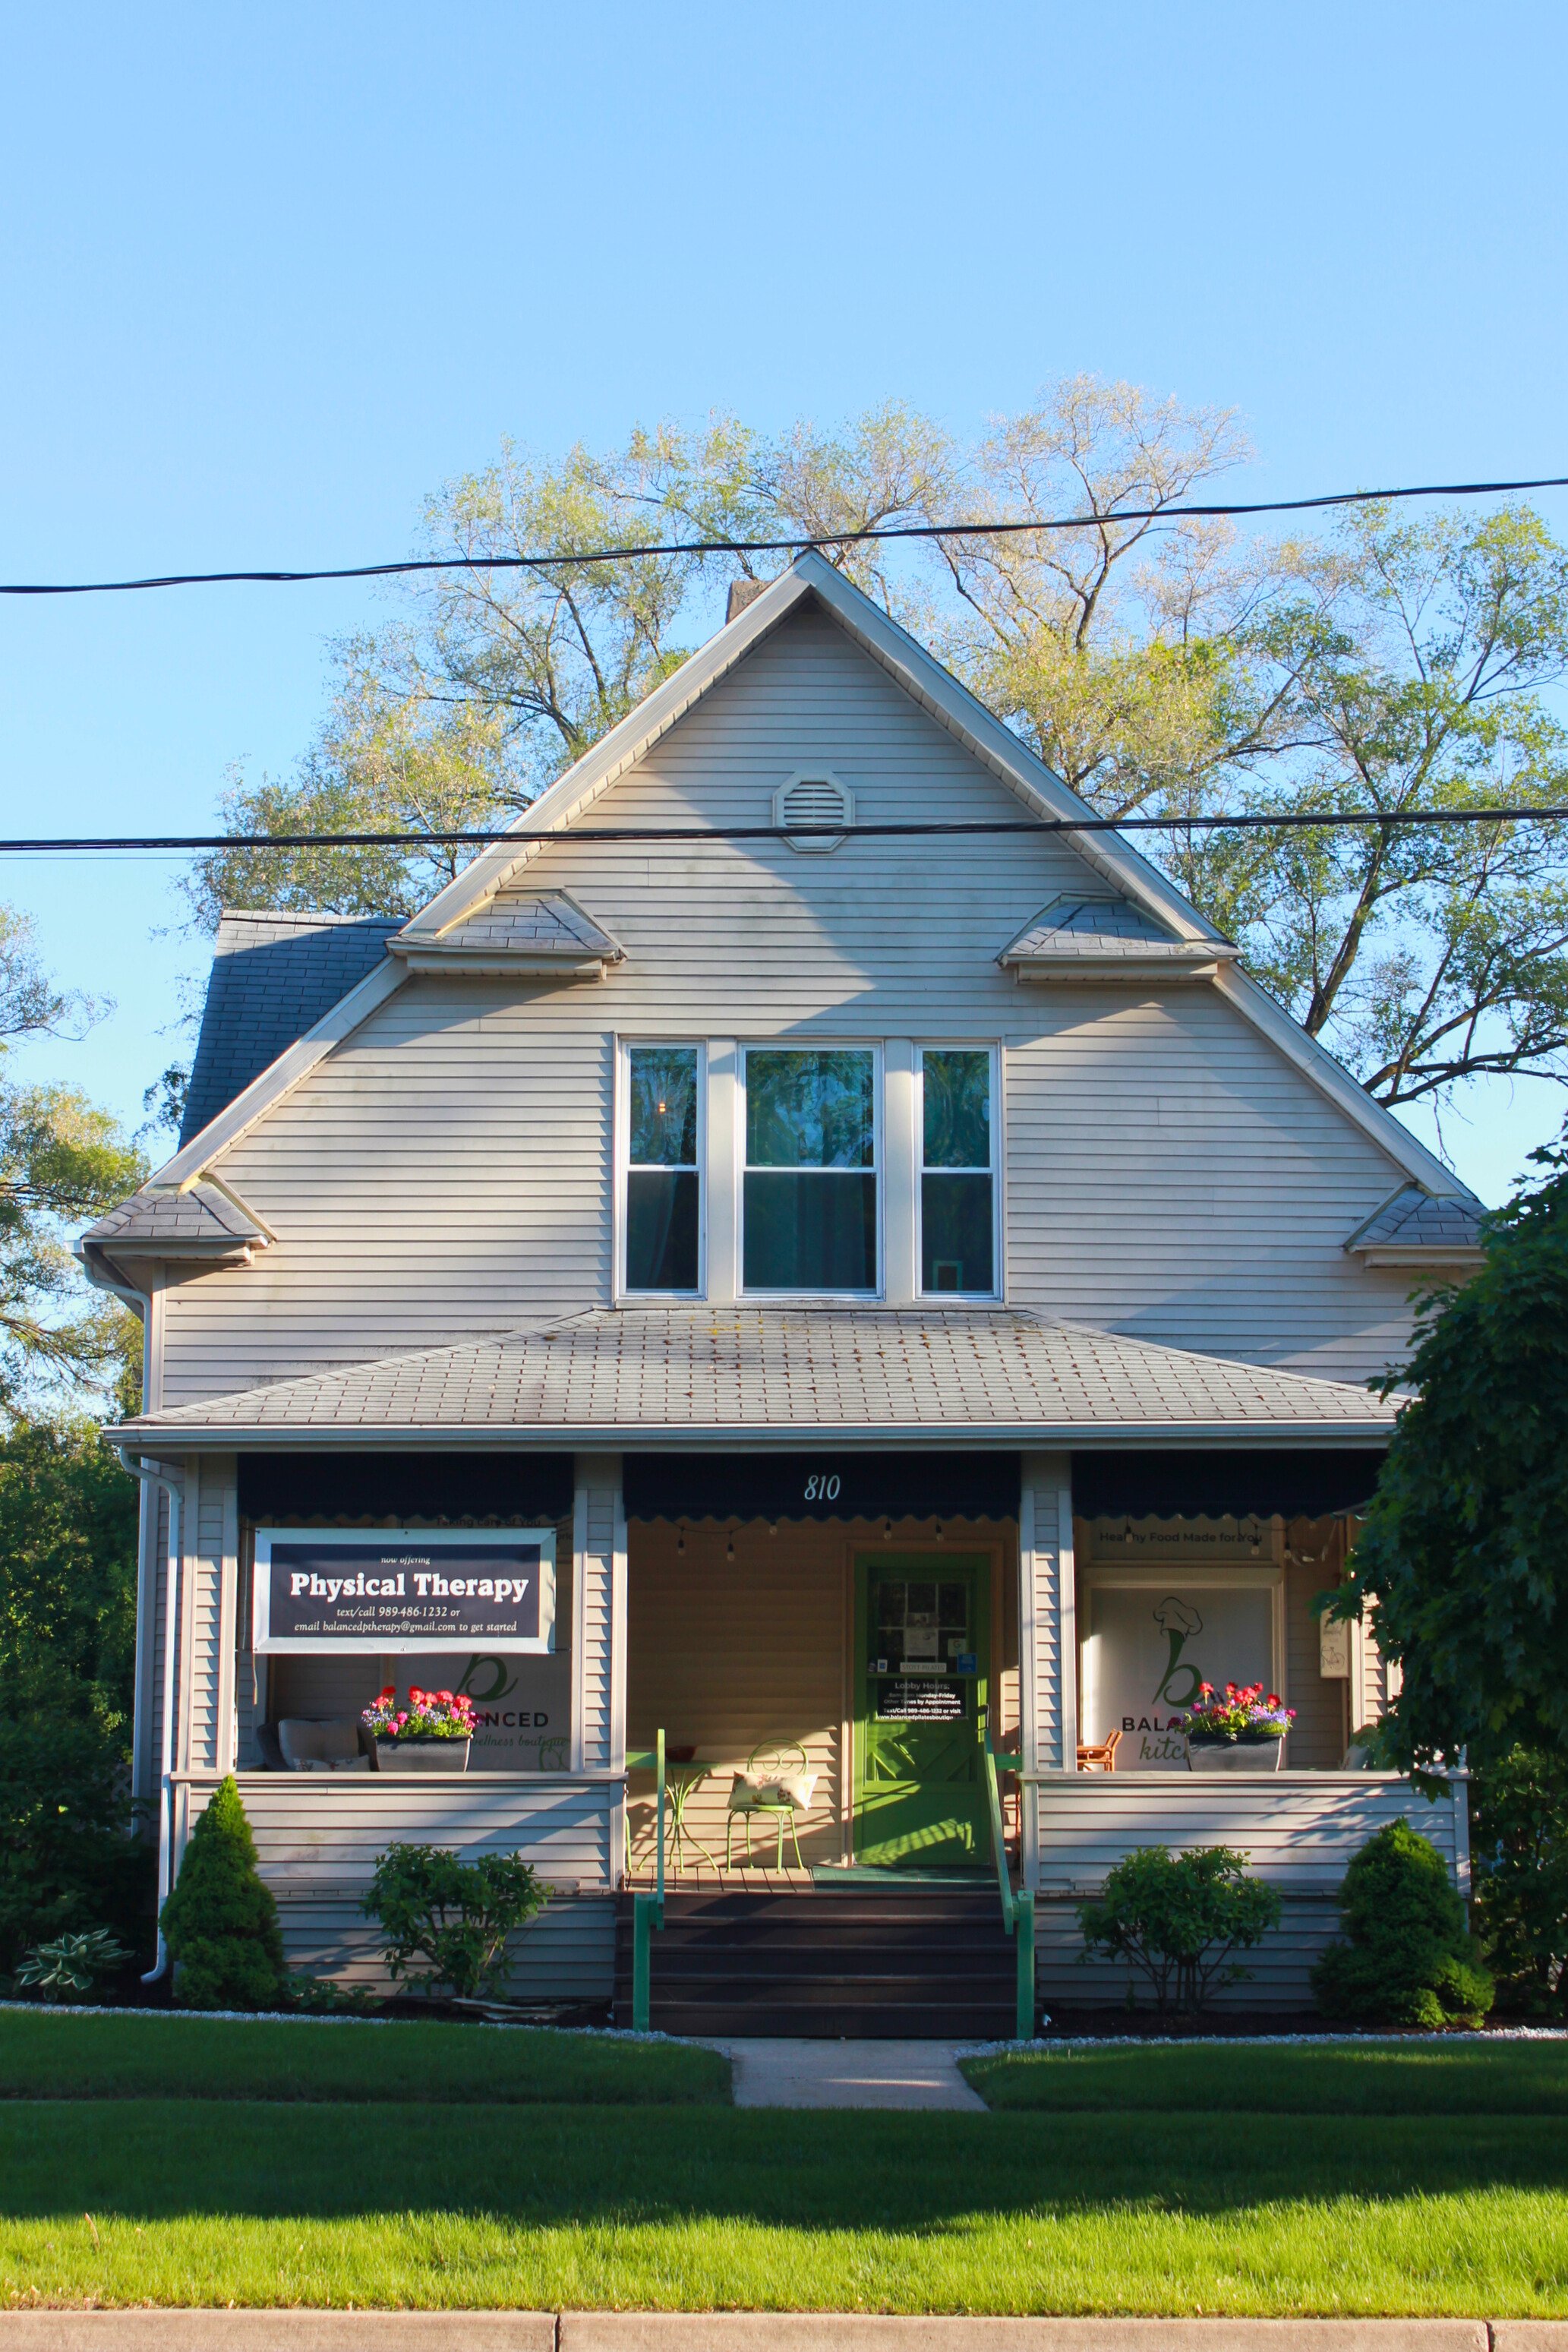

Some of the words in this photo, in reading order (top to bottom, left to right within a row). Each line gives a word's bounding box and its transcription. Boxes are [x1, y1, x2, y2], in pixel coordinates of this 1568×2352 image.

[804, 1475, 841, 1500] 810
[519, 1518, 541, 1526] You
[1100, 1532, 1146, 1543] Healhy
[1150, 1532, 1180, 1542] Food
[1184, 1532, 1216, 1542] Made
[1219, 1532, 1235, 1542] for
[399, 1554, 431, 1566] offering
[291, 1572, 406, 1603] Physical
[413, 1573, 529, 1603] Therapy
[336, 1605, 376, 1618] text/call
[450, 1609, 461, 1618] or
[294, 1621, 320, 1632] email
[323, 1620, 456, 1634] balancedptherapy@gmail.com
[459, 1621, 469, 1632] to
[471, 1622, 484, 1634] get
[486, 1621, 517, 1632] started
[894, 1682, 920, 1691] Lobby
[1139, 1736, 1187, 1760] kitc
